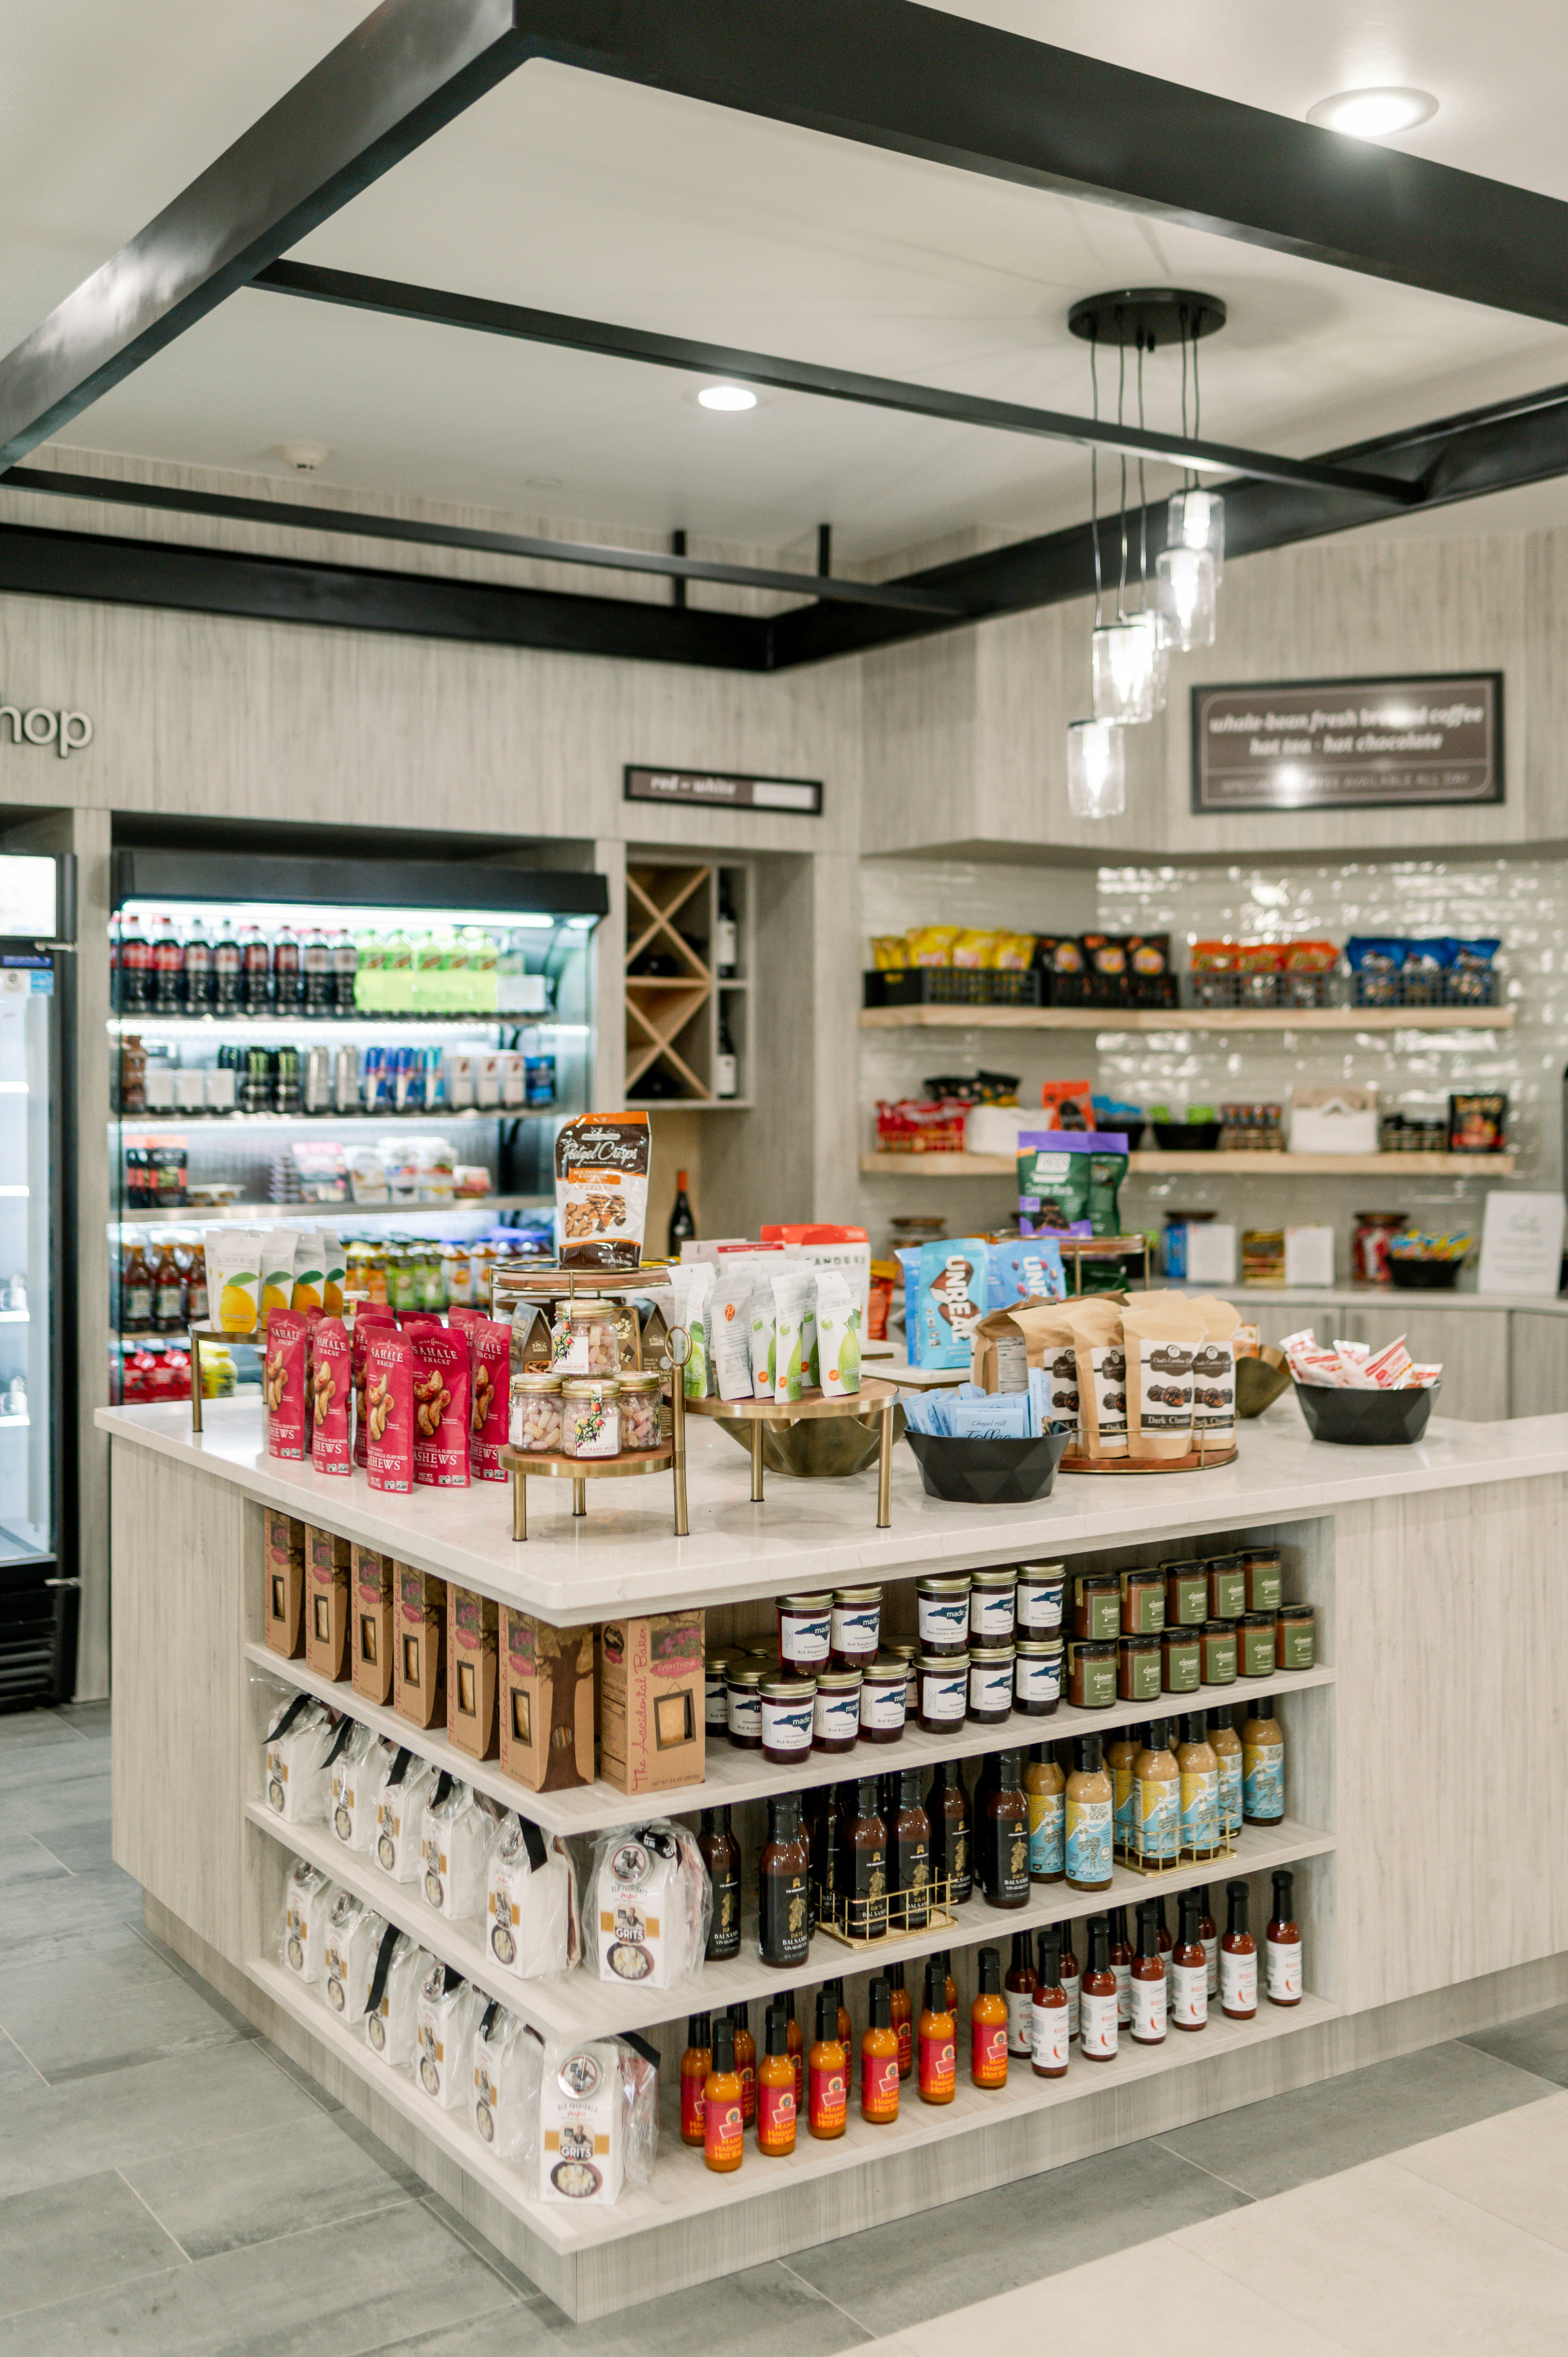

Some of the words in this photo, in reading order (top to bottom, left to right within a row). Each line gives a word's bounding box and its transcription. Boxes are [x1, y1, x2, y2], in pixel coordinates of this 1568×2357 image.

[1210, 714, 1260, 734] whole
[1265, 712, 1307, 731] bean
[1308, 708, 1358, 734] fresh
[1360, 705, 1427, 729] bred
[1429, 703, 1484, 728] coffee
[1250, 736, 1280, 756] hot
[1283, 736, 1312, 754] tea
[1323, 734, 1353, 753] hot
[1356, 733, 1443, 752] chocolate
[563, 1142, 601, 1167] Pretzel
[598, 1141, 638, 1165] Crisps
[805, 1255, 866, 1265] ANDERS
[946, 1255, 971, 1343] UNREAL
[726, 1306, 734, 1319] B
[271, 1327, 300, 1341] SAHALE
[371, 1347, 403, 1362] SAHALE
[412, 1345, 458, 1359] SAHALE
[424, 1356, 450, 1365] SNACKS
[971, 1420, 993, 1429] Chapel
[863, 1617, 878, 1626] made
[815, 1625, 830, 1634] made
[634, 1625, 648, 1674] Baker
[657, 1661, 696, 1672] EVERYTHING
[616, 1684, 626, 1696] Facts
[500, 1660, 509, 1735] Accidental
[632, 1676, 648, 1754] Accidental
[792, 1716, 810, 1725] made
[632, 1759, 648, 1792] The
[616, 1928, 643, 1940] GRITS
[569, 2103, 598, 2113] FASHIONED
[561, 2146, 592, 2159] GRITS
